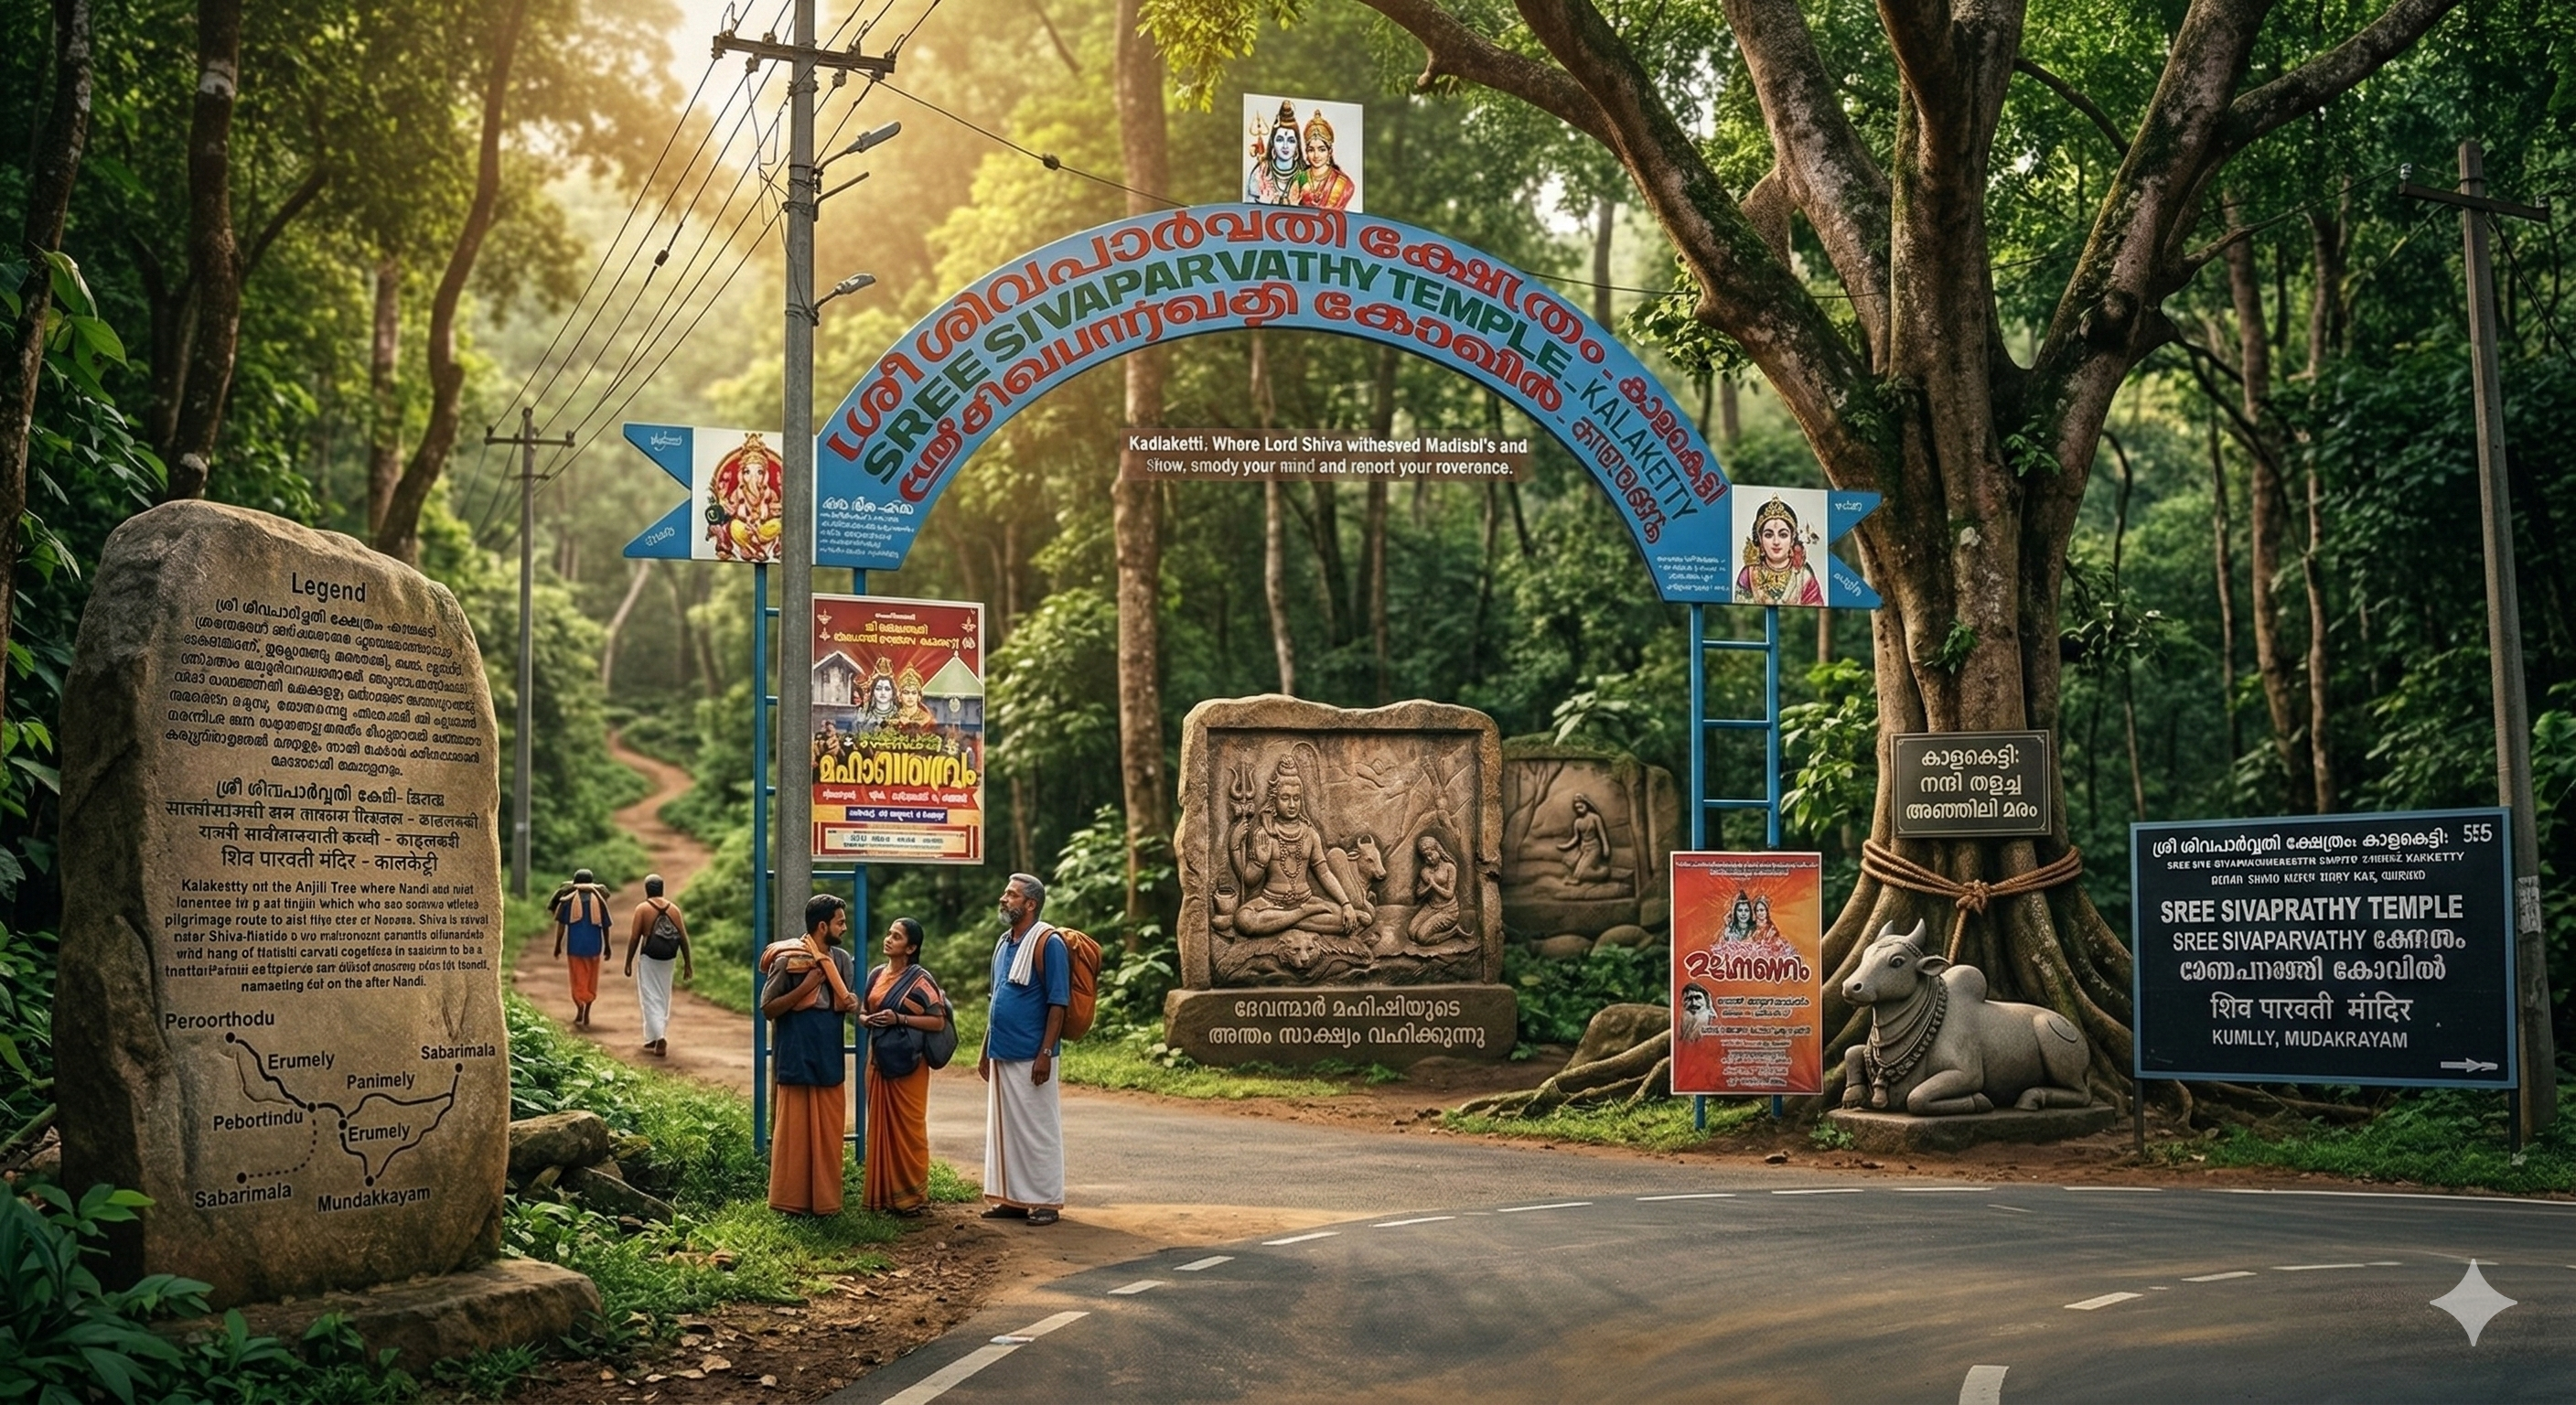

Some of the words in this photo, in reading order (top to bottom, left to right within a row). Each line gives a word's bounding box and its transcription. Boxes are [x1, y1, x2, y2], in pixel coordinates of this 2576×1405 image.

[863, 348, 993, 486] SREE
[982, 249, 1383, 364] SIVAPARVATHY
[1388, 267, 1573, 380] TEMPLE
[1580, 377, 1699, 521] KALAKETTY
[292, 572, 366, 603] Legend
[1920, 772, 1962, 793] നന്ദി
[1970, 774, 2023, 796] തളച്ച
[2002, 802, 2038, 818] മരം
[221, 844, 255, 866] शिव
[260, 847, 315, 868] पारवती
[319, 848, 357, 868] मंदिर
[182, 879, 248, 895] Kalakestty
[273, 881, 292, 893] the
[295, 881, 327, 896] Anjili
[331, 882, 356, 894] Tree
[360, 882, 395, 895] where
[399, 883, 429, 895] Nandi
[2160, 900, 2215, 924] SREE
[2221, 896, 2361, 923] SIVAPRATHY
[2367, 895, 2463, 919] TEMPLE
[165, 914, 231, 928] pilgrimage
[235, 916, 267, 926] route
[271, 915, 283, 926] to
[419, 914, 447, 925] Shiva
[2173, 932, 2218, 950] SREE
[2222, 929, 2367, 950] SIVAPARVATHY
[207, 948, 238, 960] hang
[242, 946, 254, 958] of
[449, 945, 460, 955] to
[477, 946, 483, 954] a
[327, 979, 341, 989] on
[345, 977, 362, 989] the
[365, 976, 391, 988] after
[393, 975, 426, 988] Nandi.
[1333, 995, 1461, 1023] മഹിഷിയുടെ
[2210, 991, 2254, 1019] शिव
[2259, 991, 2334, 1020] पारवती
[165, 1010, 274, 1030] Peroorthodu
[1279, 1026, 1361, 1049] സാക്ഷ്യം
[1368, 1023, 1486, 1049] വഹിക്കുന്നു
[2212, 1030, 2280, 1048] KUMLLY,
[2285, 1031, 2408, 1049] MUDAKRAYAM
[268, 1051, 336, 1071] Erumely
[421, 1043, 496, 1060] Sabarimala
[347, 1071, 415, 1089] Panimely
[213, 1109, 304, 1132] Pebortindu
[349, 1122, 411, 1142] Erumely
[194, 1183, 292, 1209] Sabarimala
[317, 1187, 431, 1213] Mundakkayam
